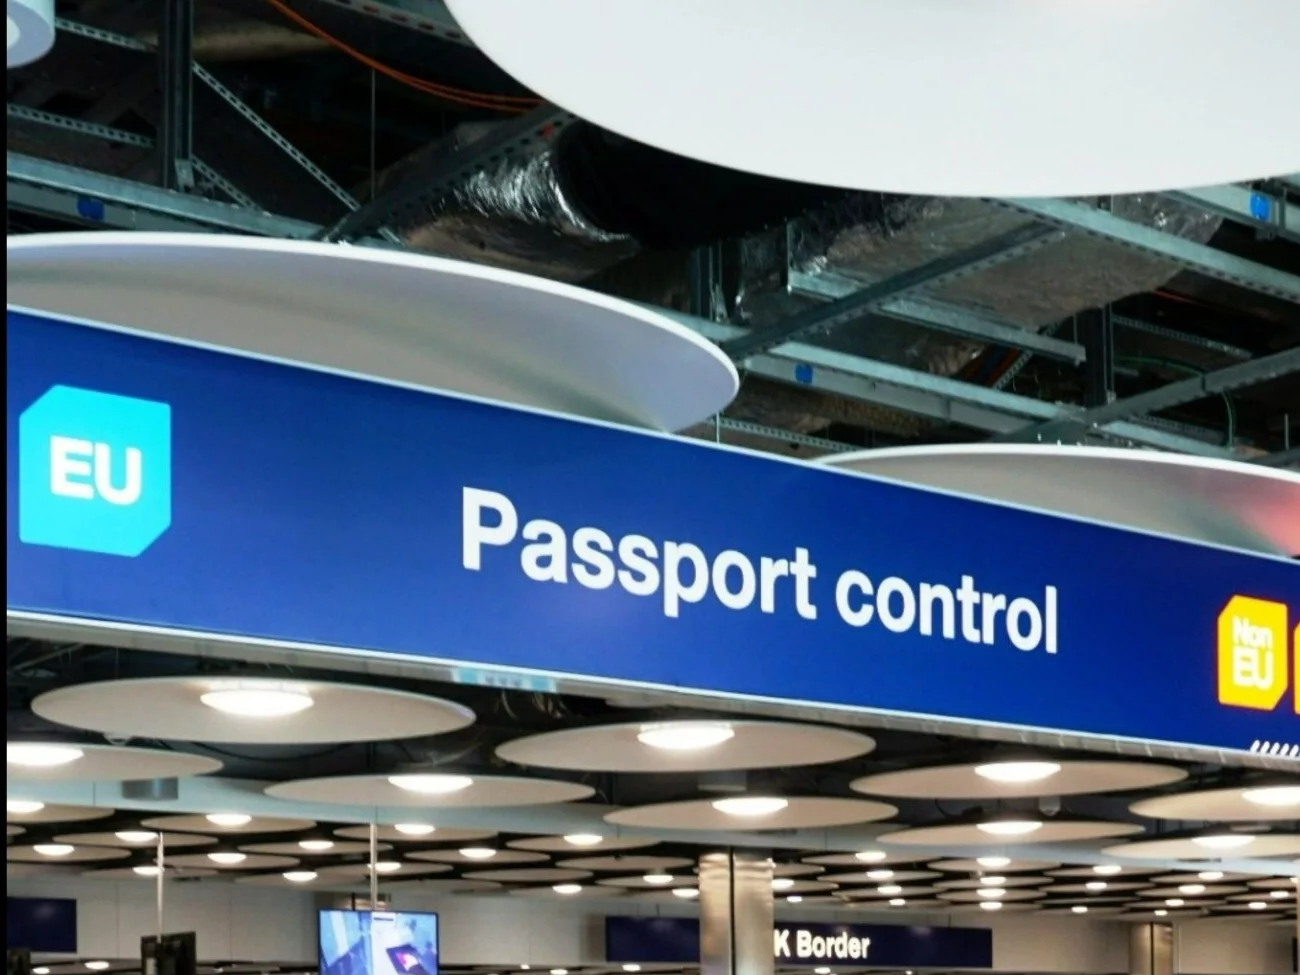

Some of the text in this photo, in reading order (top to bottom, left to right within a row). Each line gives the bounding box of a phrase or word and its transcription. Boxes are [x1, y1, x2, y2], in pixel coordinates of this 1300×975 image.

[49, 435, 143, 506] EU
[462, 486, 1058, 655] Passport control
[1231, 615, 1274, 650] Non
[1231, 645, 1275, 690] EU
[773, 928, 871, 960] K Border
